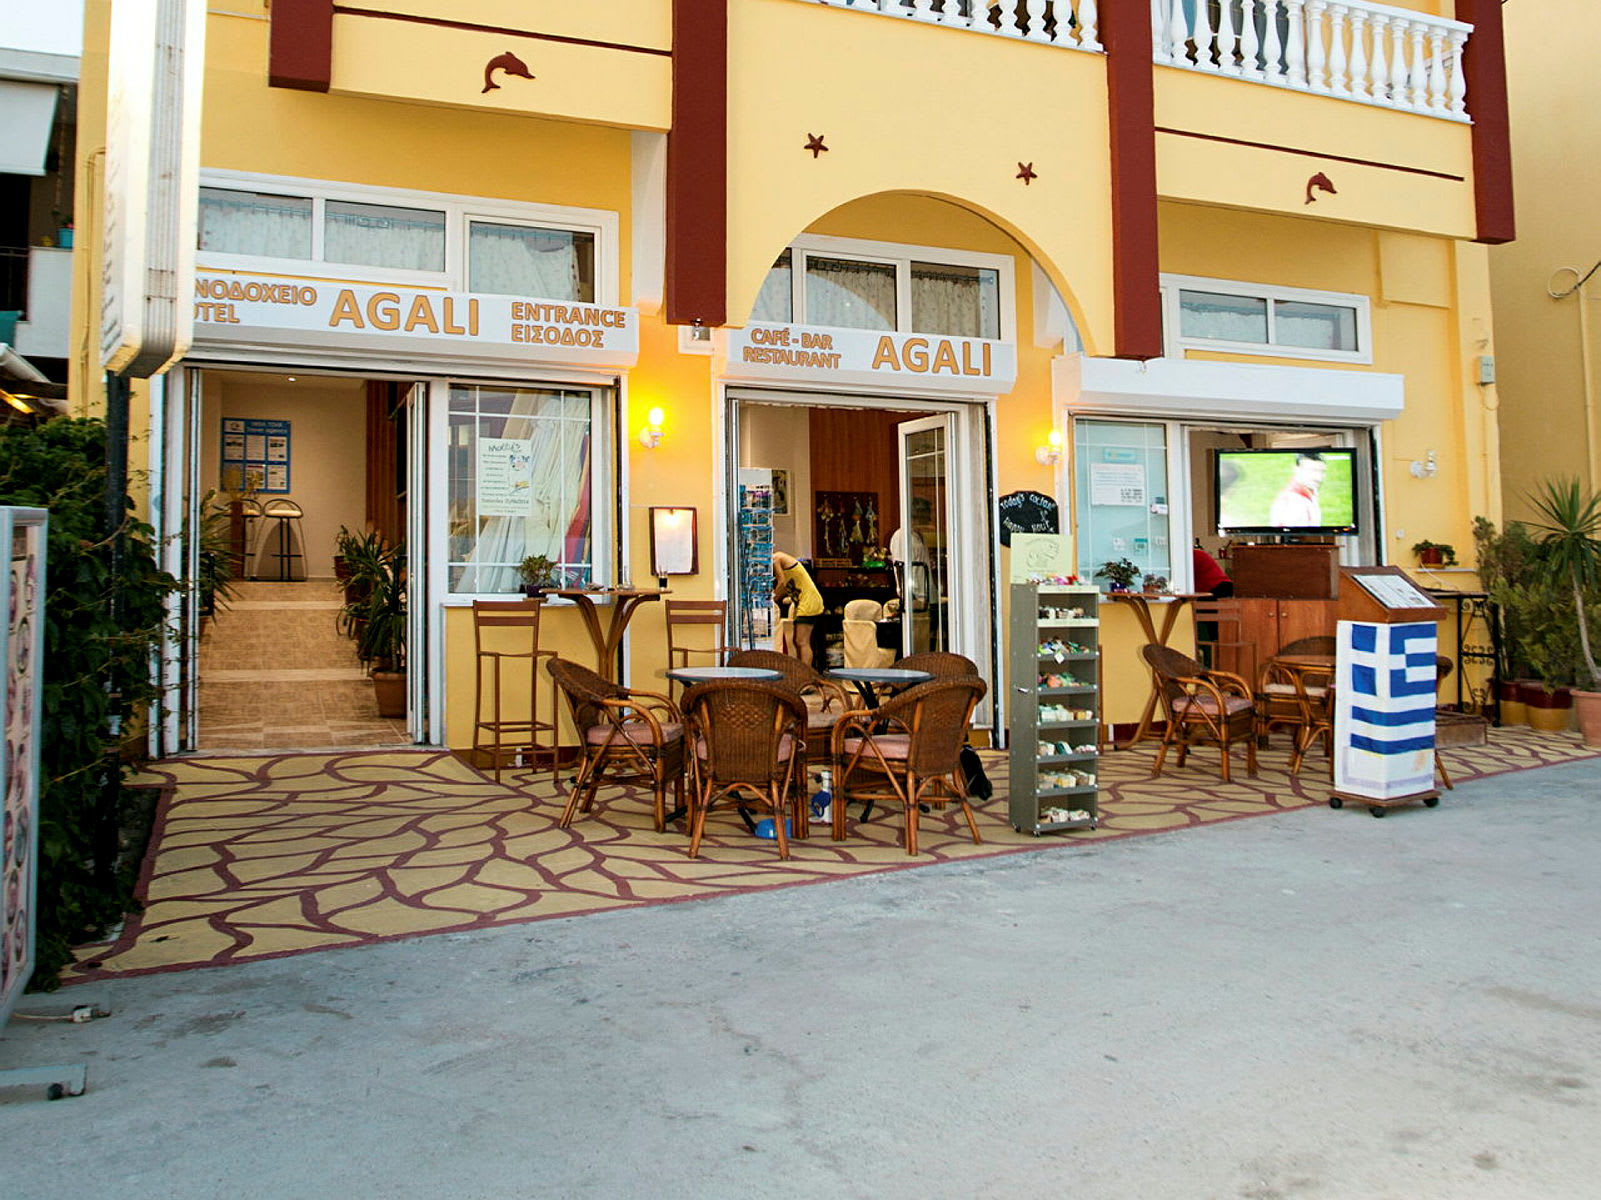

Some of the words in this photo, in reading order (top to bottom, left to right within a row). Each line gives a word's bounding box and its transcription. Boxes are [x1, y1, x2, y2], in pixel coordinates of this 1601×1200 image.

[194, 302, 240, 323] TEL
[329, 289, 479, 336] AGALI
[511, 302, 626, 328] ENTRANCE
[511, 323, 604, 348] ΕΙΣΟΔΟΣ
[751, 327, 790, 346] CAFÉ
[801, 332, 833, 350] BAR
[743, 346, 841, 369] RESTAURANT
[872, 336, 991, 376] AGALI
